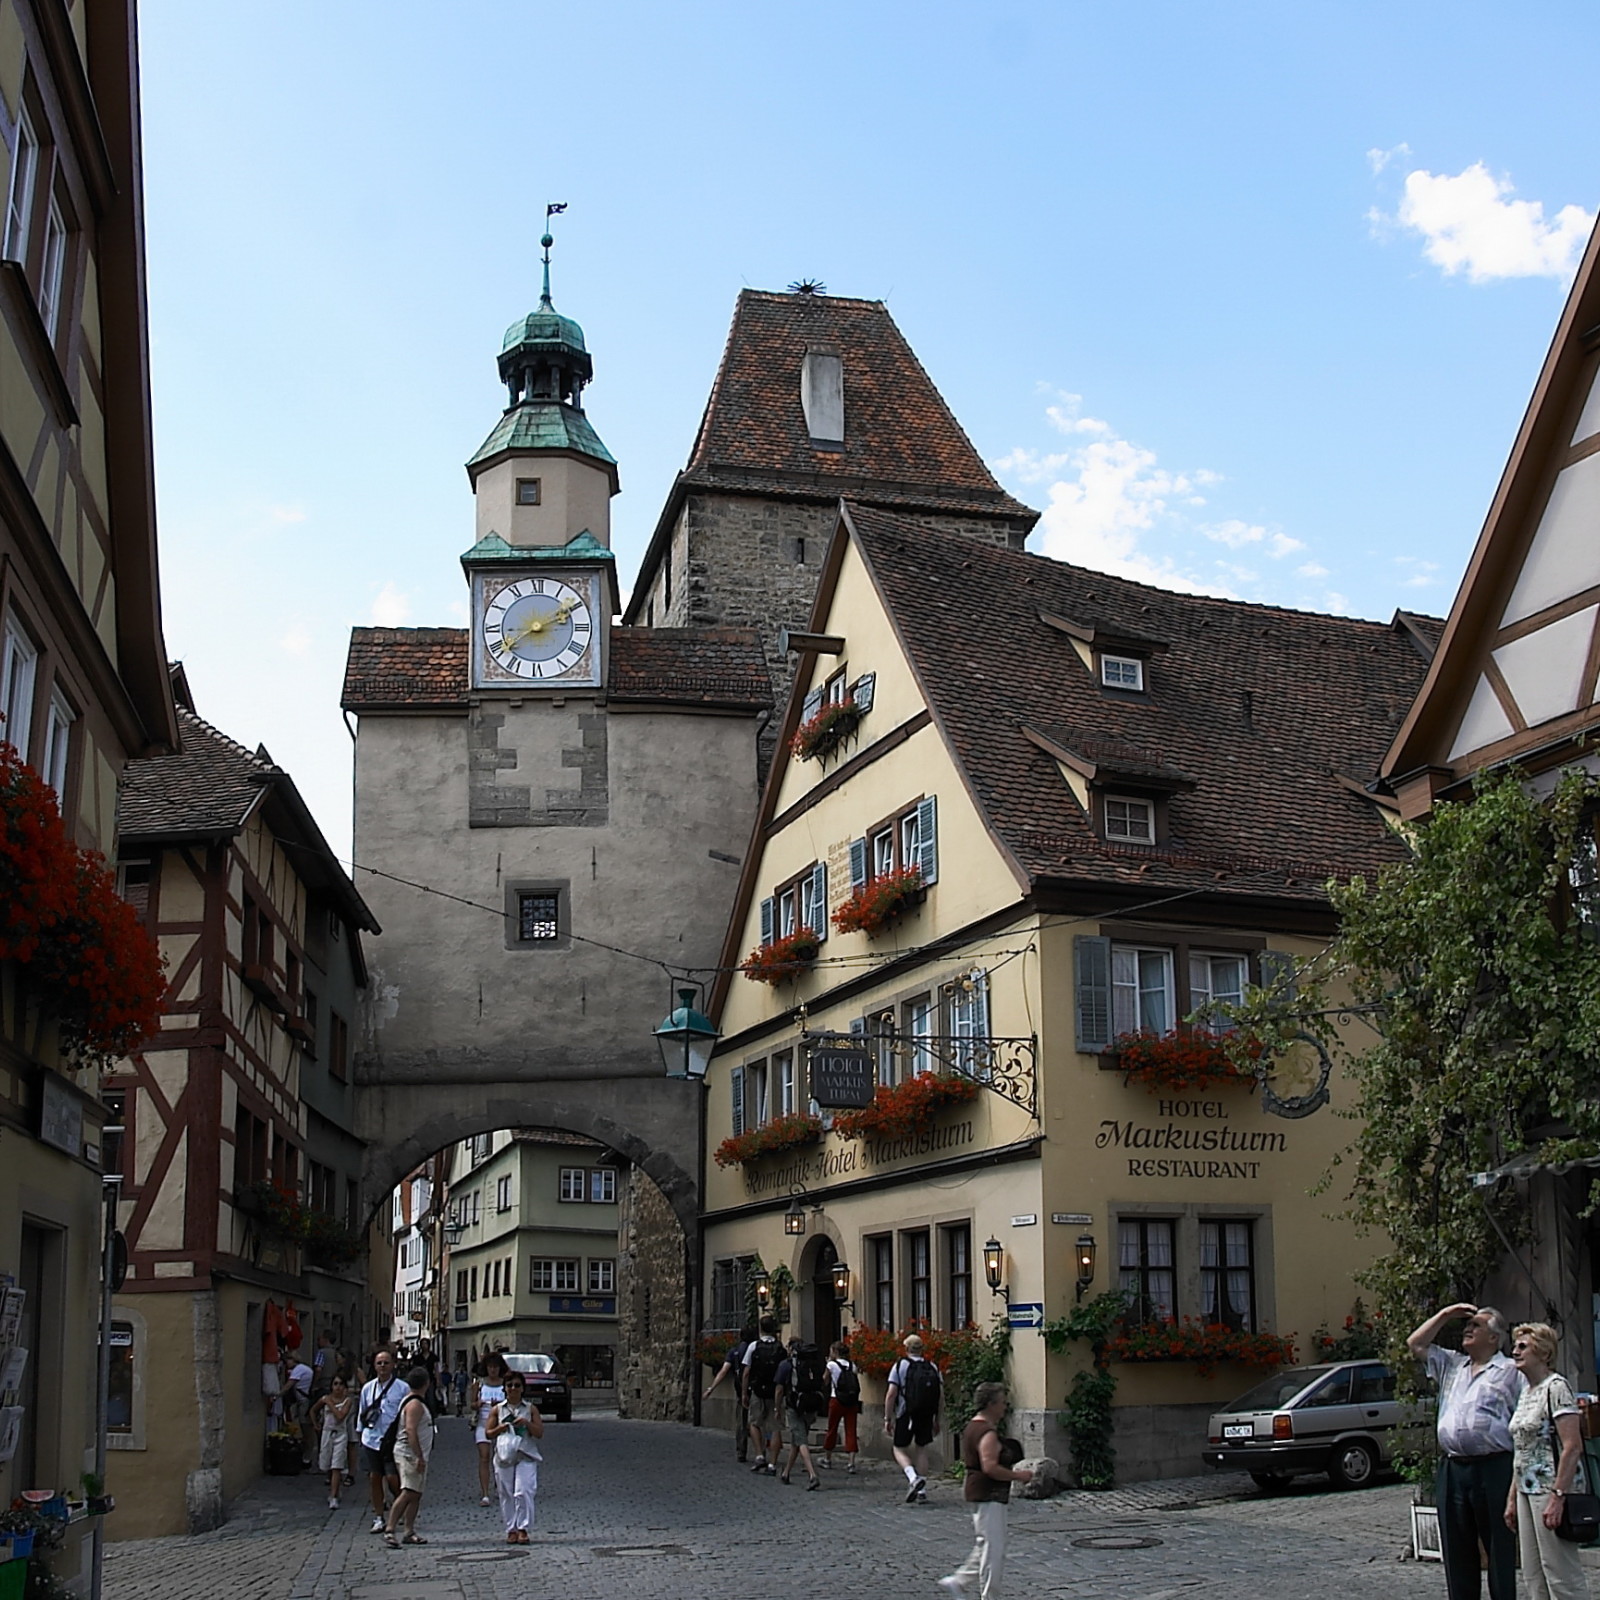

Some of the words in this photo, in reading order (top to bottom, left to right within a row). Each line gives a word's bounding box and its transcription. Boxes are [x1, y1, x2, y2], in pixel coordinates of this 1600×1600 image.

[822, 1057, 863, 1073] HOTEL
[821, 1076, 866, 1088] MARKUS
[1159, 1100, 1228, 1119] HOTEL
[860, 1121, 974, 1170] Markusturm
[1095, 1120, 1288, 1152] Markusturm
[1128, 1159, 1260, 1179] RESTAURANT
